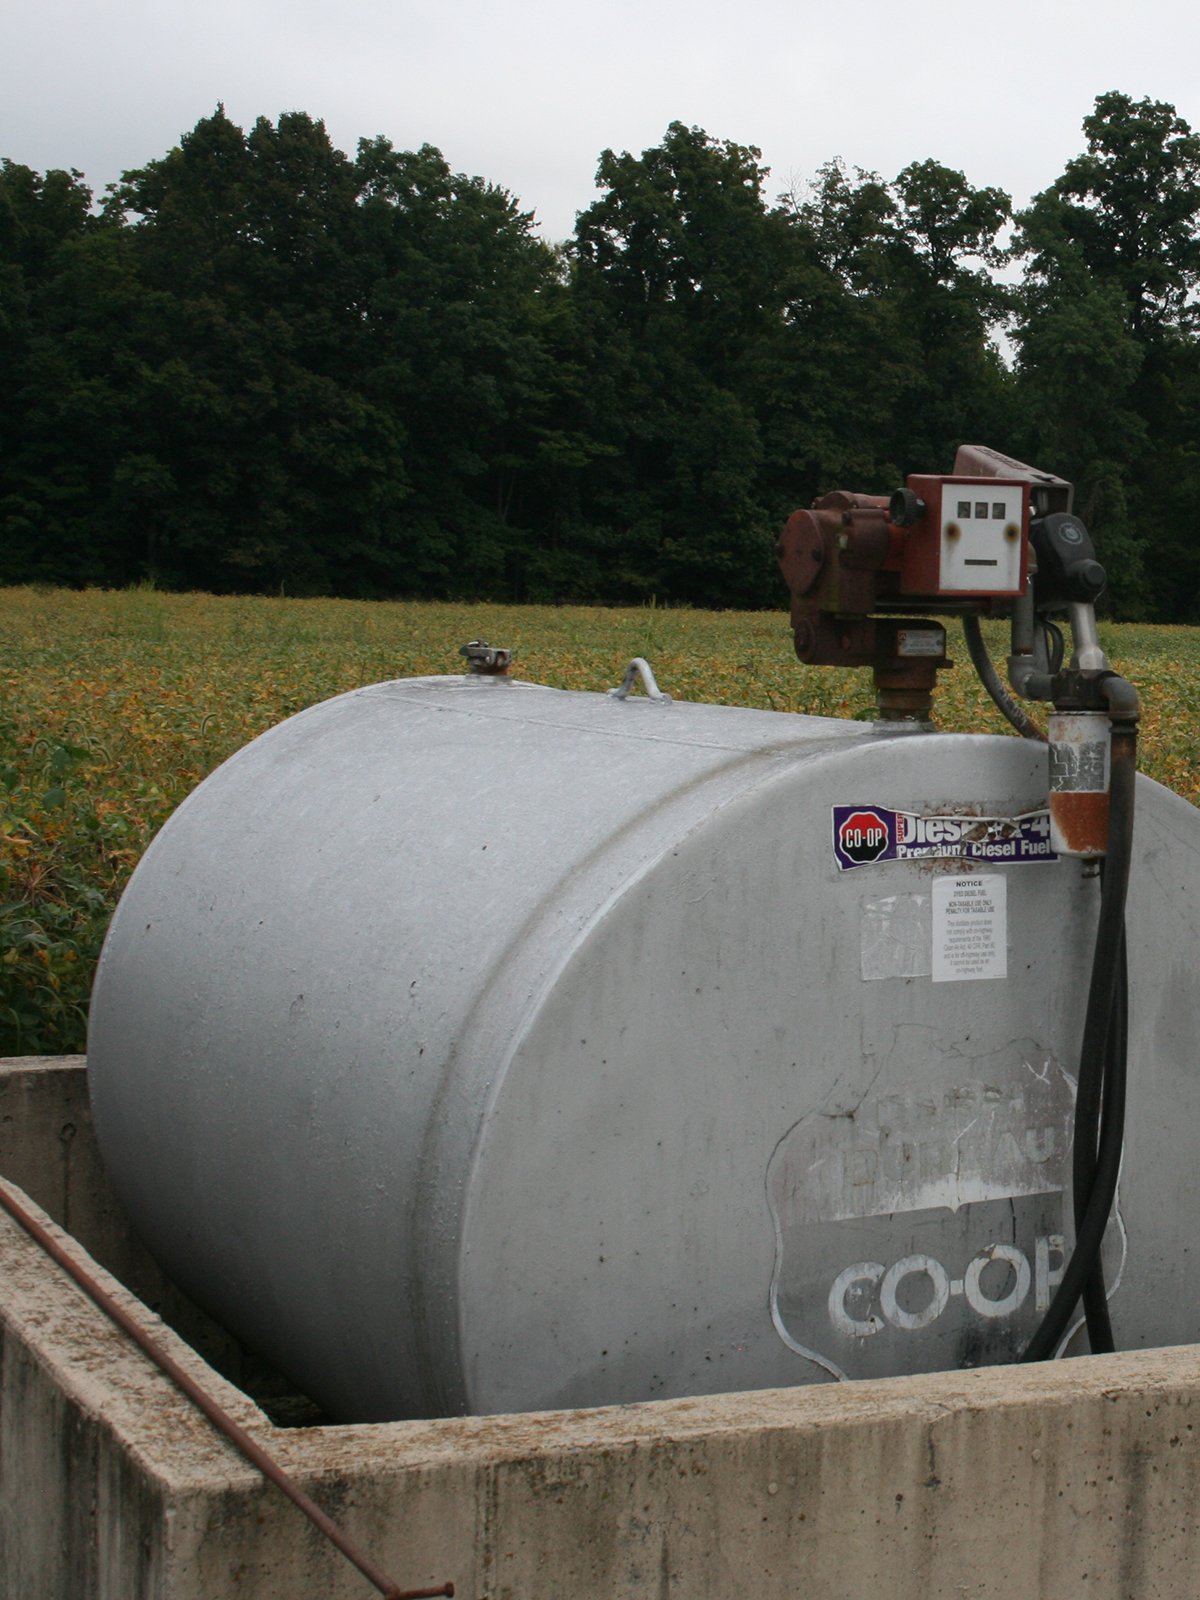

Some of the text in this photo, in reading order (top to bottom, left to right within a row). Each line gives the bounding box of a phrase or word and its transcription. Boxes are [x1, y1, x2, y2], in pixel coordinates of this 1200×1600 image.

[846, 827, 882, 848] CO-OP
[896, 815, 1050, 844] Dies-4
[972, 841, 1016, 857] Diesel
[1021, 838, 1051, 855] Fuel
[828, 1234, 1066, 1337] CO-OP
